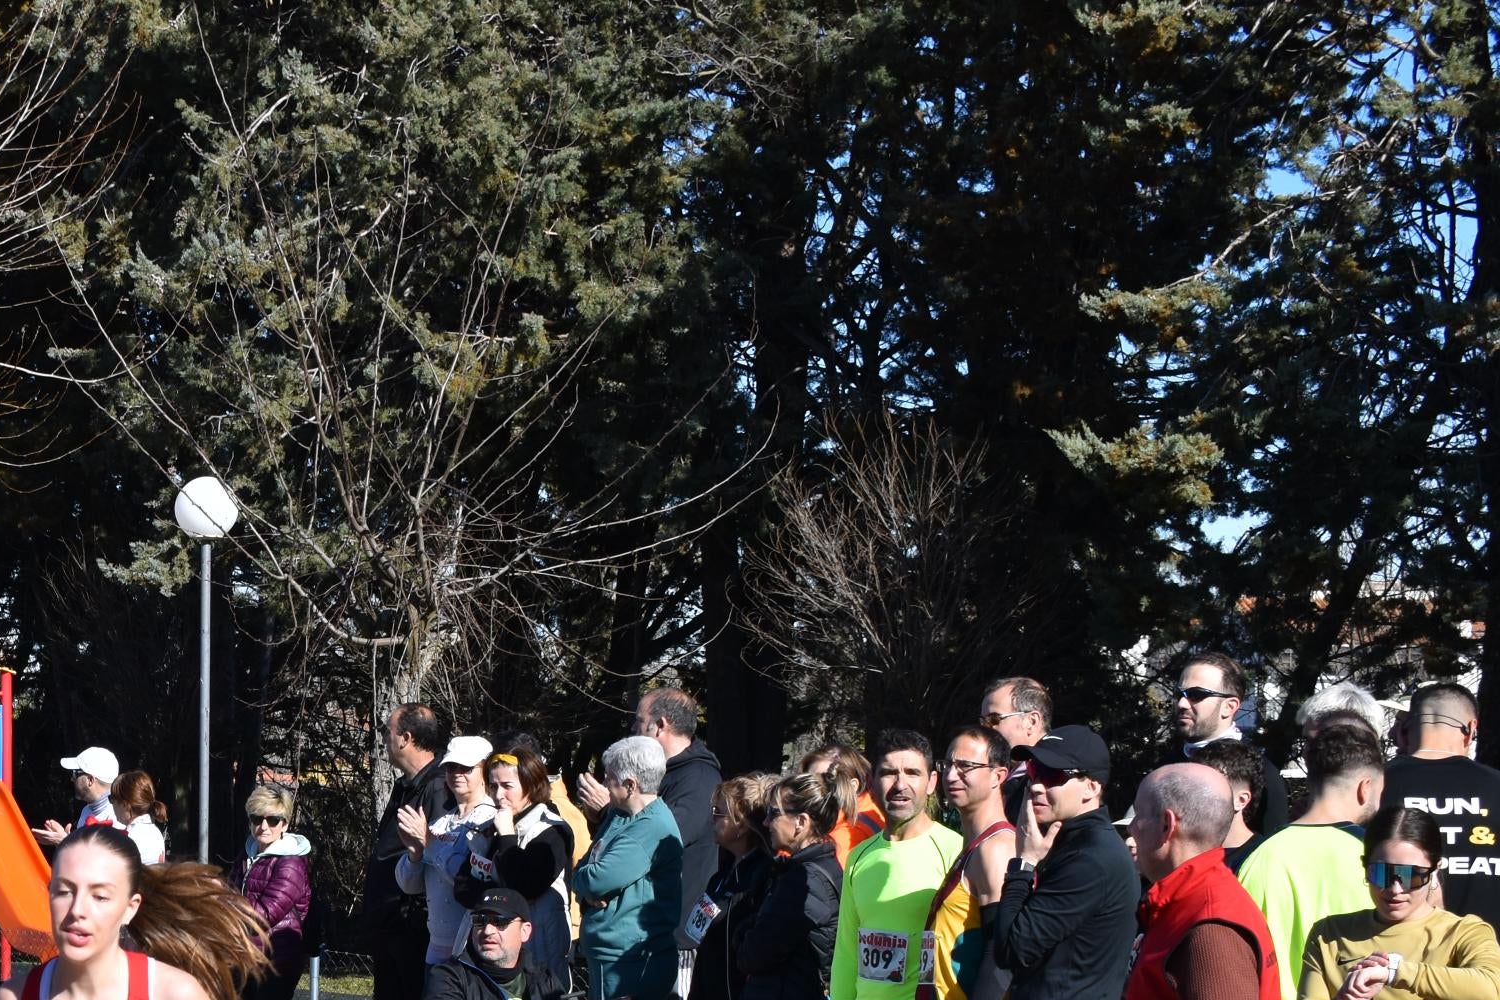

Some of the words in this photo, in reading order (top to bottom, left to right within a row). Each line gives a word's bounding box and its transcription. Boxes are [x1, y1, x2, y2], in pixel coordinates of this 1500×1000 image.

[1404, 797, 1488, 817] RUN,
[1440, 827, 1463, 845] T
[1469, 826, 1495, 845] &
[863, 947, 894, 970] 309
